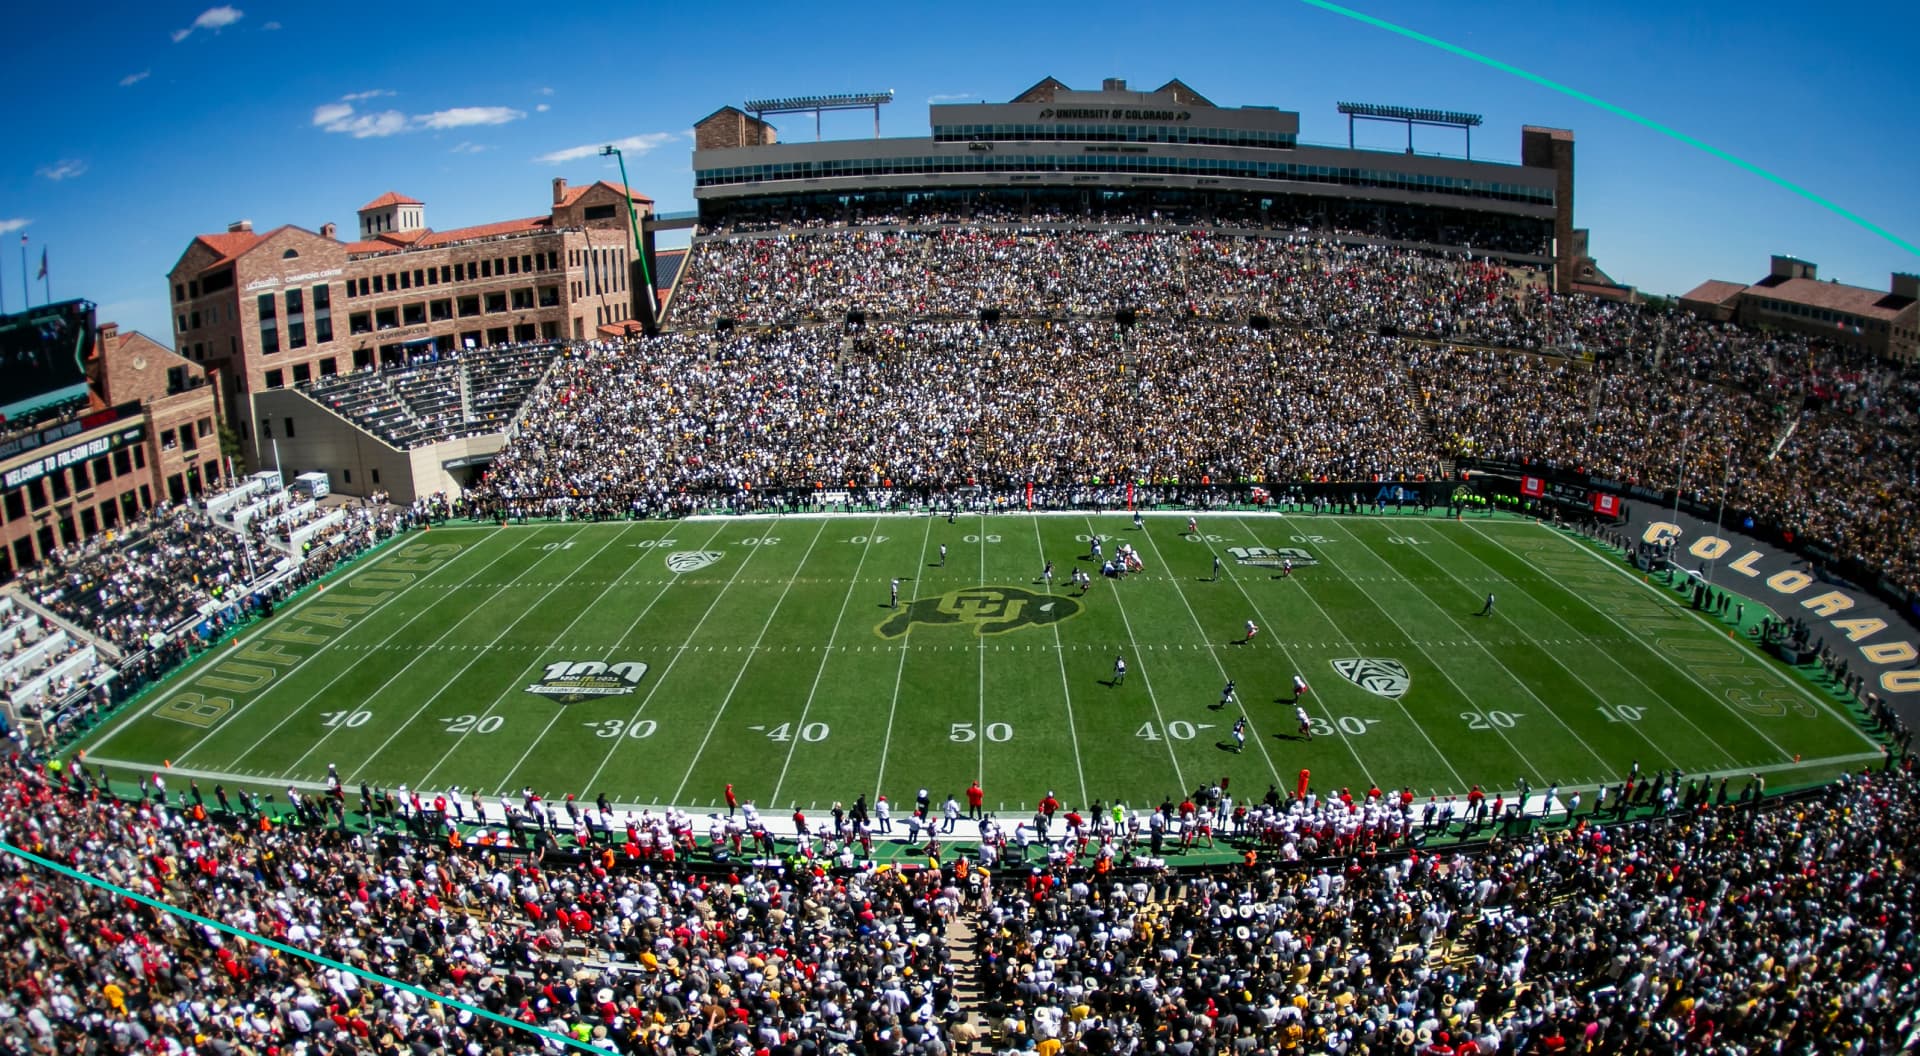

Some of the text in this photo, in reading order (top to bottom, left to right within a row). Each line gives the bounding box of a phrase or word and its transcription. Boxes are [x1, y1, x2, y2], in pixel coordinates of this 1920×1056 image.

[1056, 108, 1175, 121] UNIVERSITY OF COLORADO
[5, 437, 110, 487] WELCOME TO FOLSOM FIELD
[1376, 485, 1420, 500] Afac
[1642, 521, 1920, 693] COLORADO
[152, 544, 462, 728] BUFFALOES
[543, 661, 648, 683] 100
[1361, 678, 1402, 695] 12
[322, 710, 373, 728] 10
[1459, 710, 1516, 730] 20
[1595, 704, 1643, 723] 10
[445, 714, 504, 734] 20
[596, 719, 657, 739] 30
[766, 722, 830, 742] 40
[949, 722, 1014, 742] 50
[1135, 720, 1196, 741] 40
[1310, 716, 1367, 736] 30
